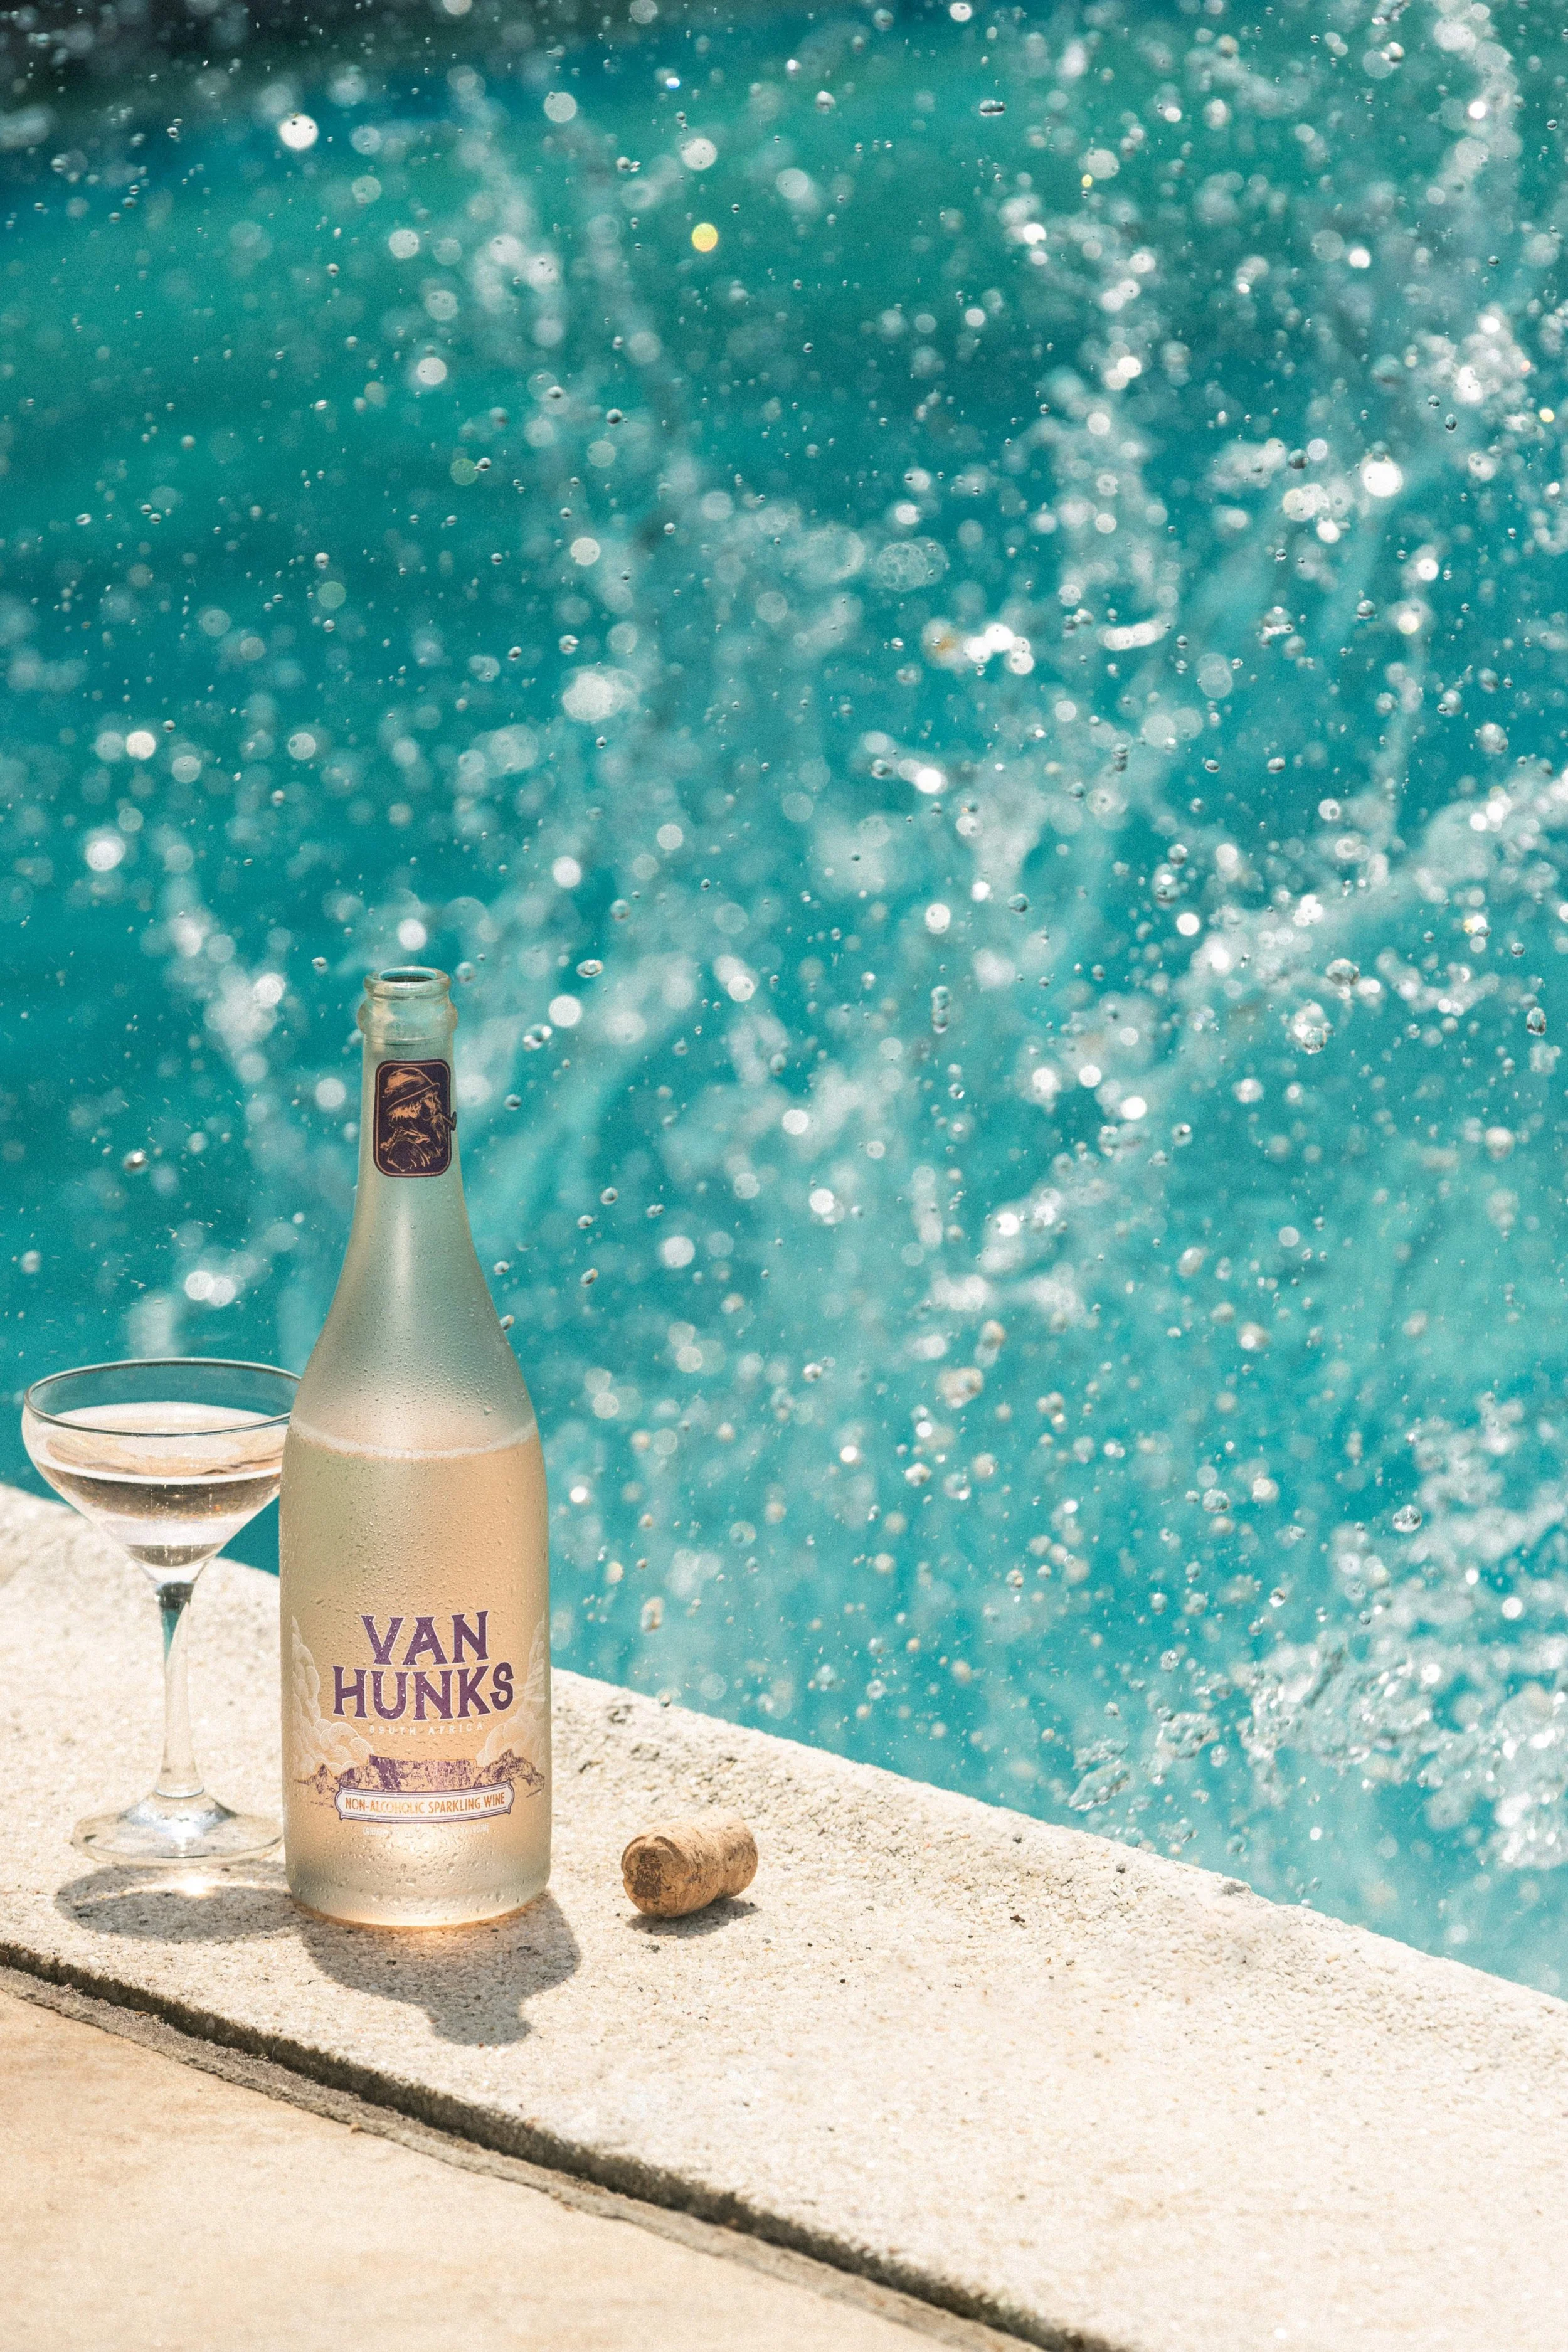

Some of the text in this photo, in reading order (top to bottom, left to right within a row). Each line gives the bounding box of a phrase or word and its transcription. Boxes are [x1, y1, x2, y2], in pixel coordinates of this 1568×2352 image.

[360, 1610, 489, 1666] VAN
[332, 1661, 514, 1720] HUNKS
[428, 1722, 483, 1735] AFRICA
[345, 1792, 505, 1814] NON-ALCOHOLIC SPARKLING WINE
